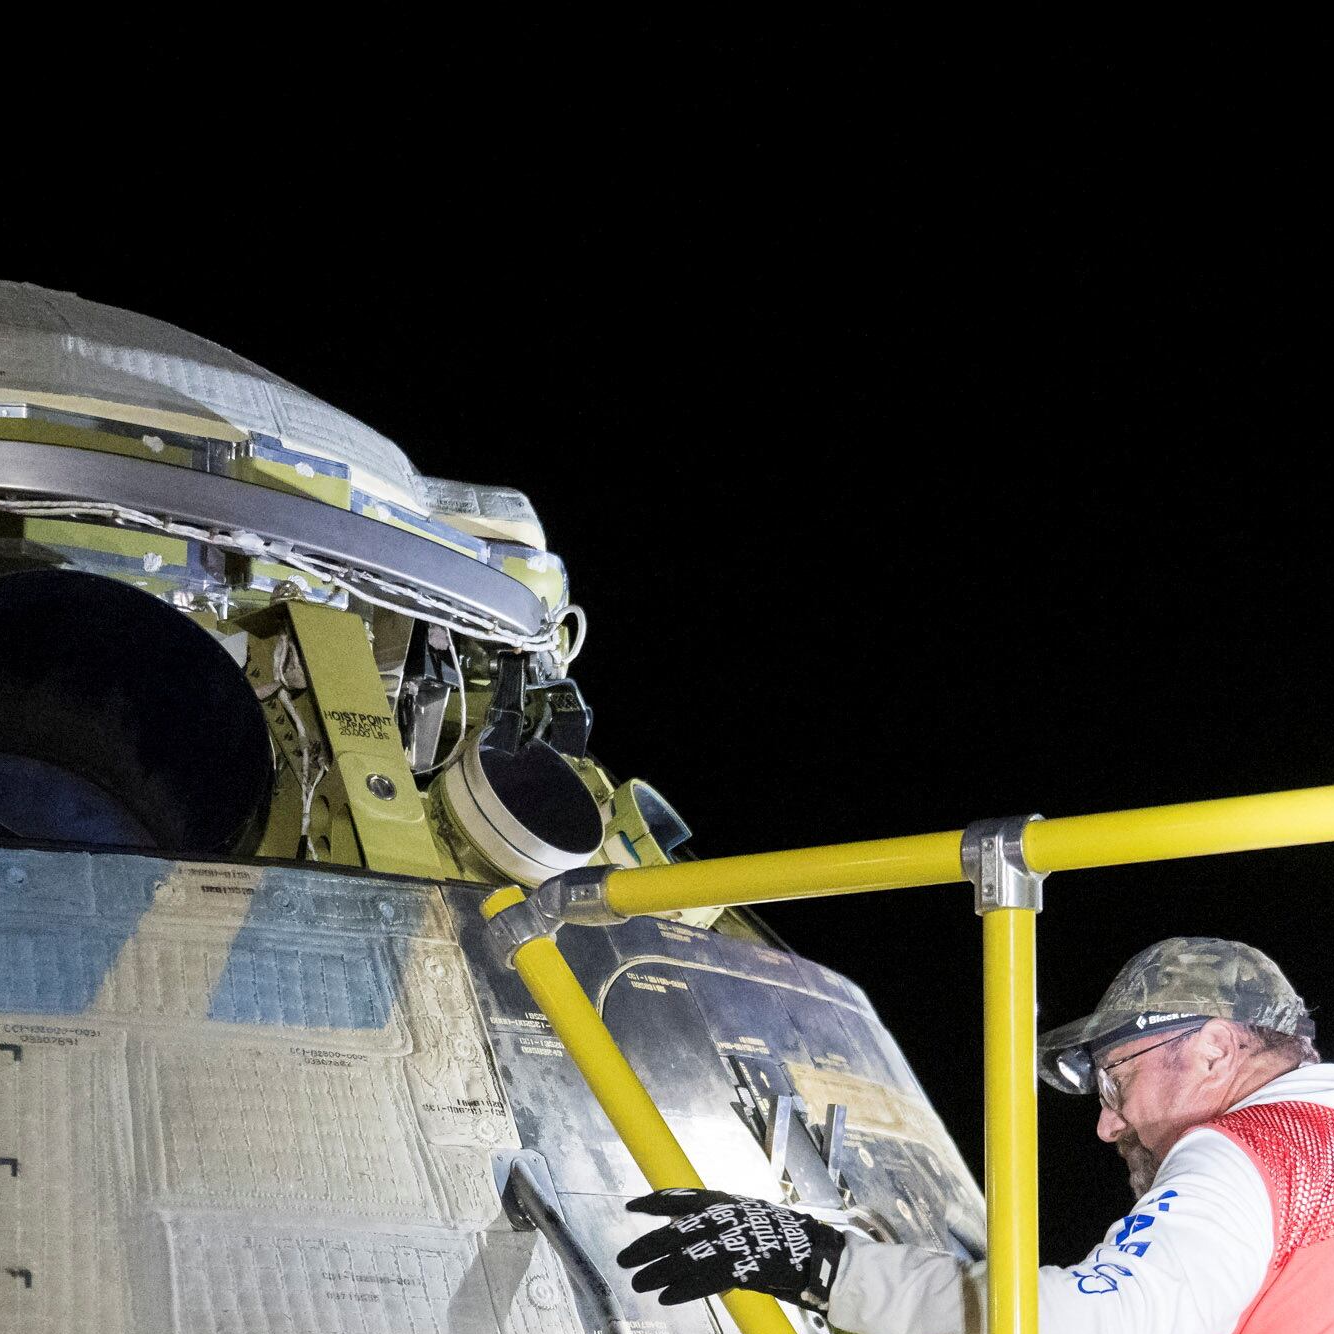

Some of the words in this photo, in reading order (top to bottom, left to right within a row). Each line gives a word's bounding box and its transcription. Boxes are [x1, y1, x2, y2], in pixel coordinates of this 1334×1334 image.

[323, 710, 358, 722] HOIST
[358, 714, 392, 726] POINT
[1148, 1013, 1180, 1025] Black
